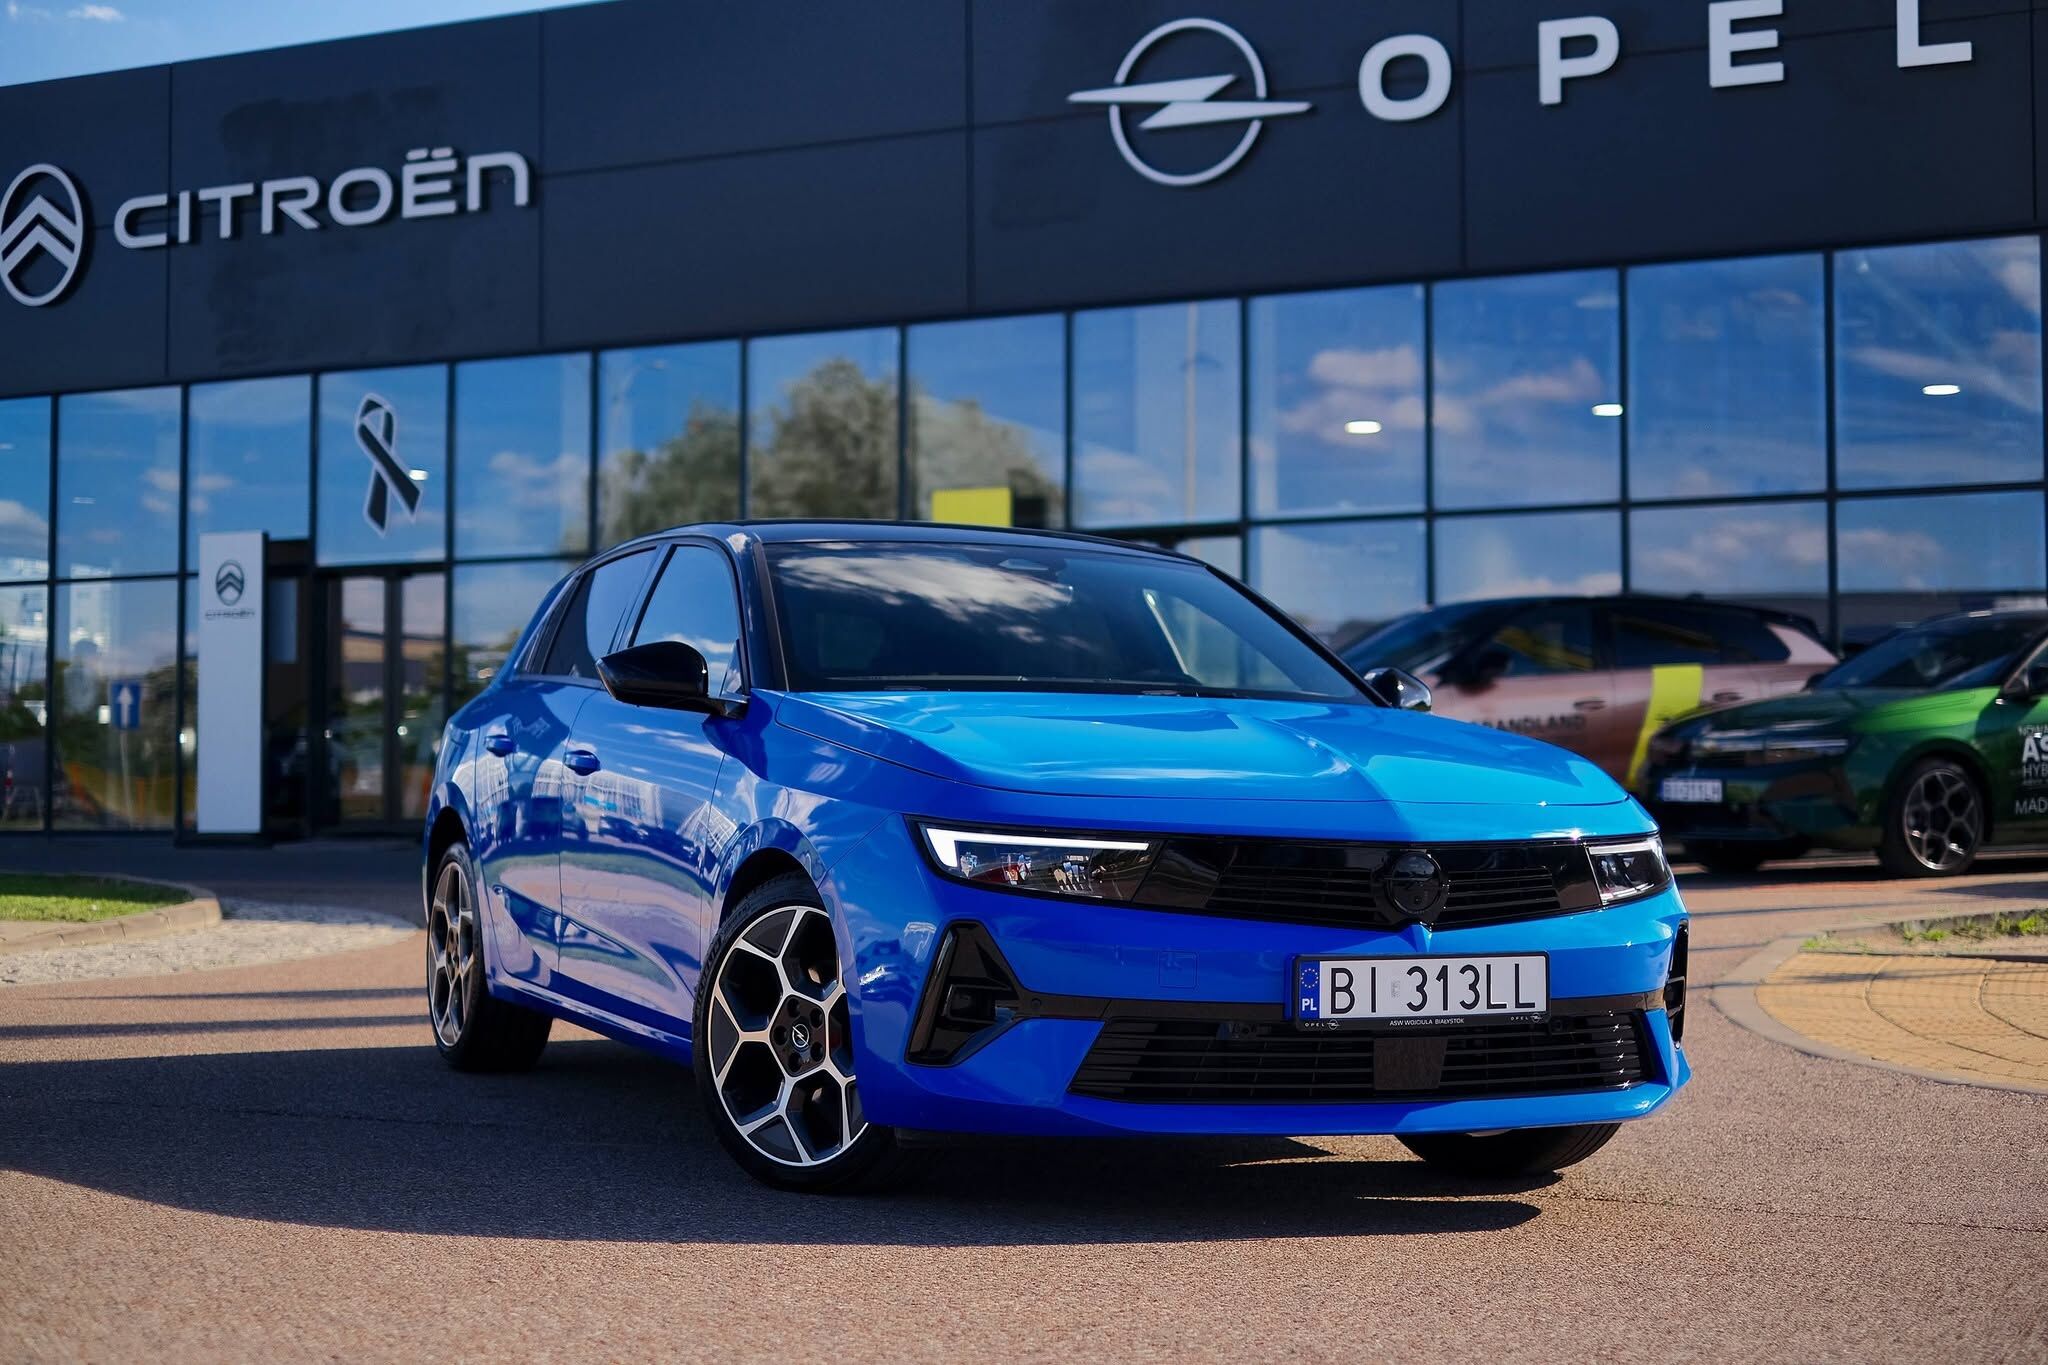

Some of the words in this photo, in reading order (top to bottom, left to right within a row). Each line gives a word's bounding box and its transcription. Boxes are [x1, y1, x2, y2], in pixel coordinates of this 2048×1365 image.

[1358, 0, 1973, 122] OPEL
[1301, 998, 1318, 1011] PL
[1330, 966, 1377, 1015] BI
[1406, 962, 1536, 1013] 313LL
